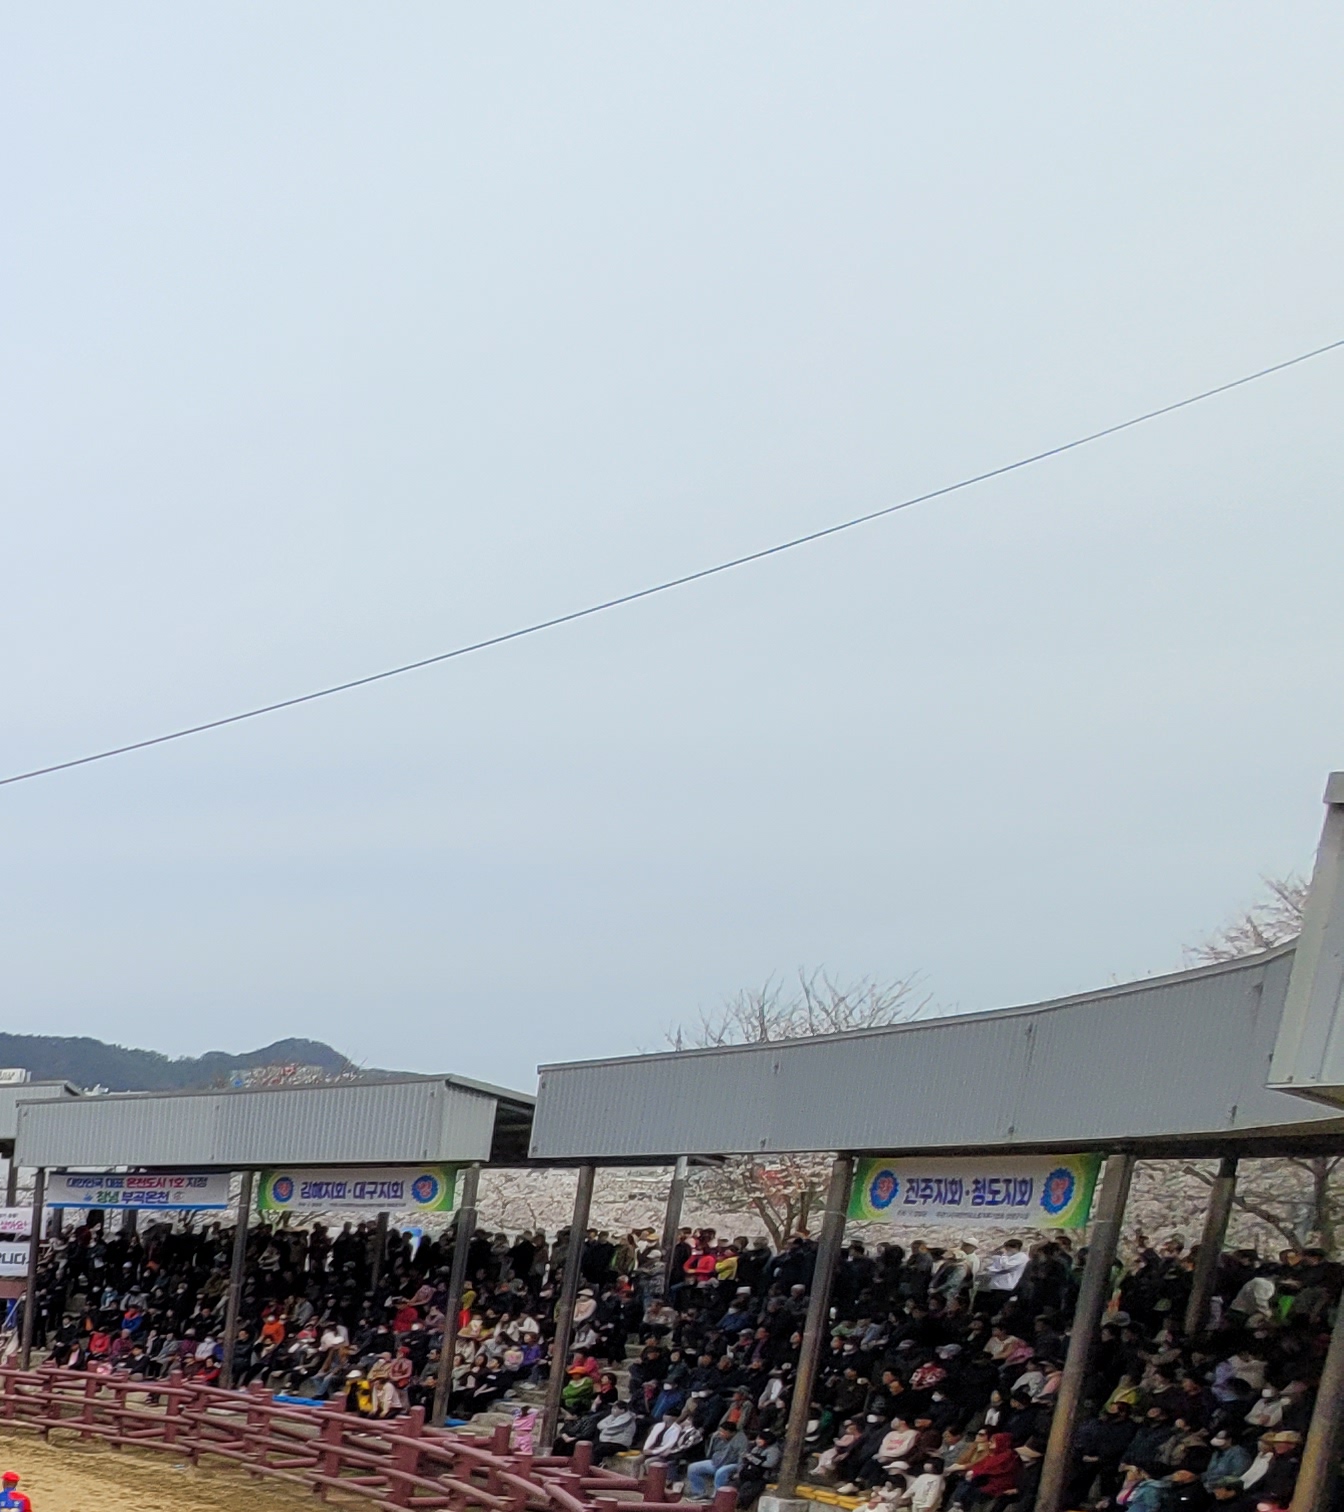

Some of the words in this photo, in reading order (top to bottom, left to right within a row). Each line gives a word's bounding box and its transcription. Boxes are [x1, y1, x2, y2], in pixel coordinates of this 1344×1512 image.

[126, 1177, 166, 1188] 온천도시
[185, 1177, 208, 1188] 지정
[122, 1191, 170, 1204] 부곡온천
